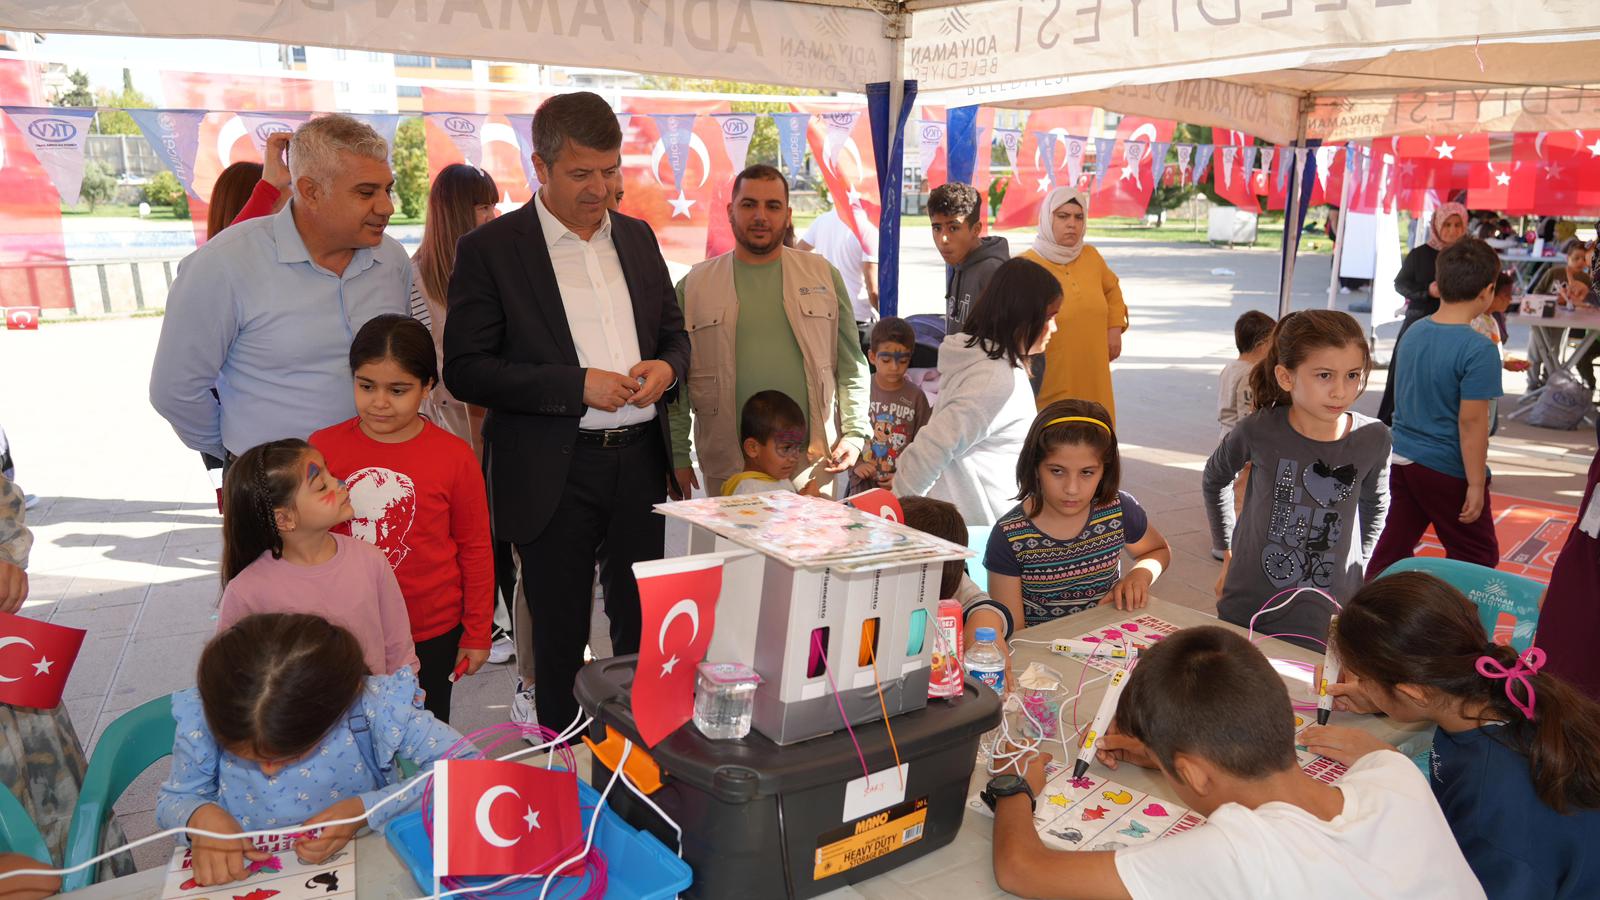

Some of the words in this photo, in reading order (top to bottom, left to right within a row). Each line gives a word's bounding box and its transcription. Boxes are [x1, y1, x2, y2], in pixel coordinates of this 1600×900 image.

[869, 401, 882, 414] ST
[889, 402, 916, 422] PUPS
[1469, 589, 1515, 606] ADIYAMAN
[854, 812, 888, 835] MANO
[843, 843, 873, 863] HEAVY
[875, 832, 898, 850] DUTY
[849, 851, 876, 867] STORAGE
[877, 846, 890, 856] BOX
